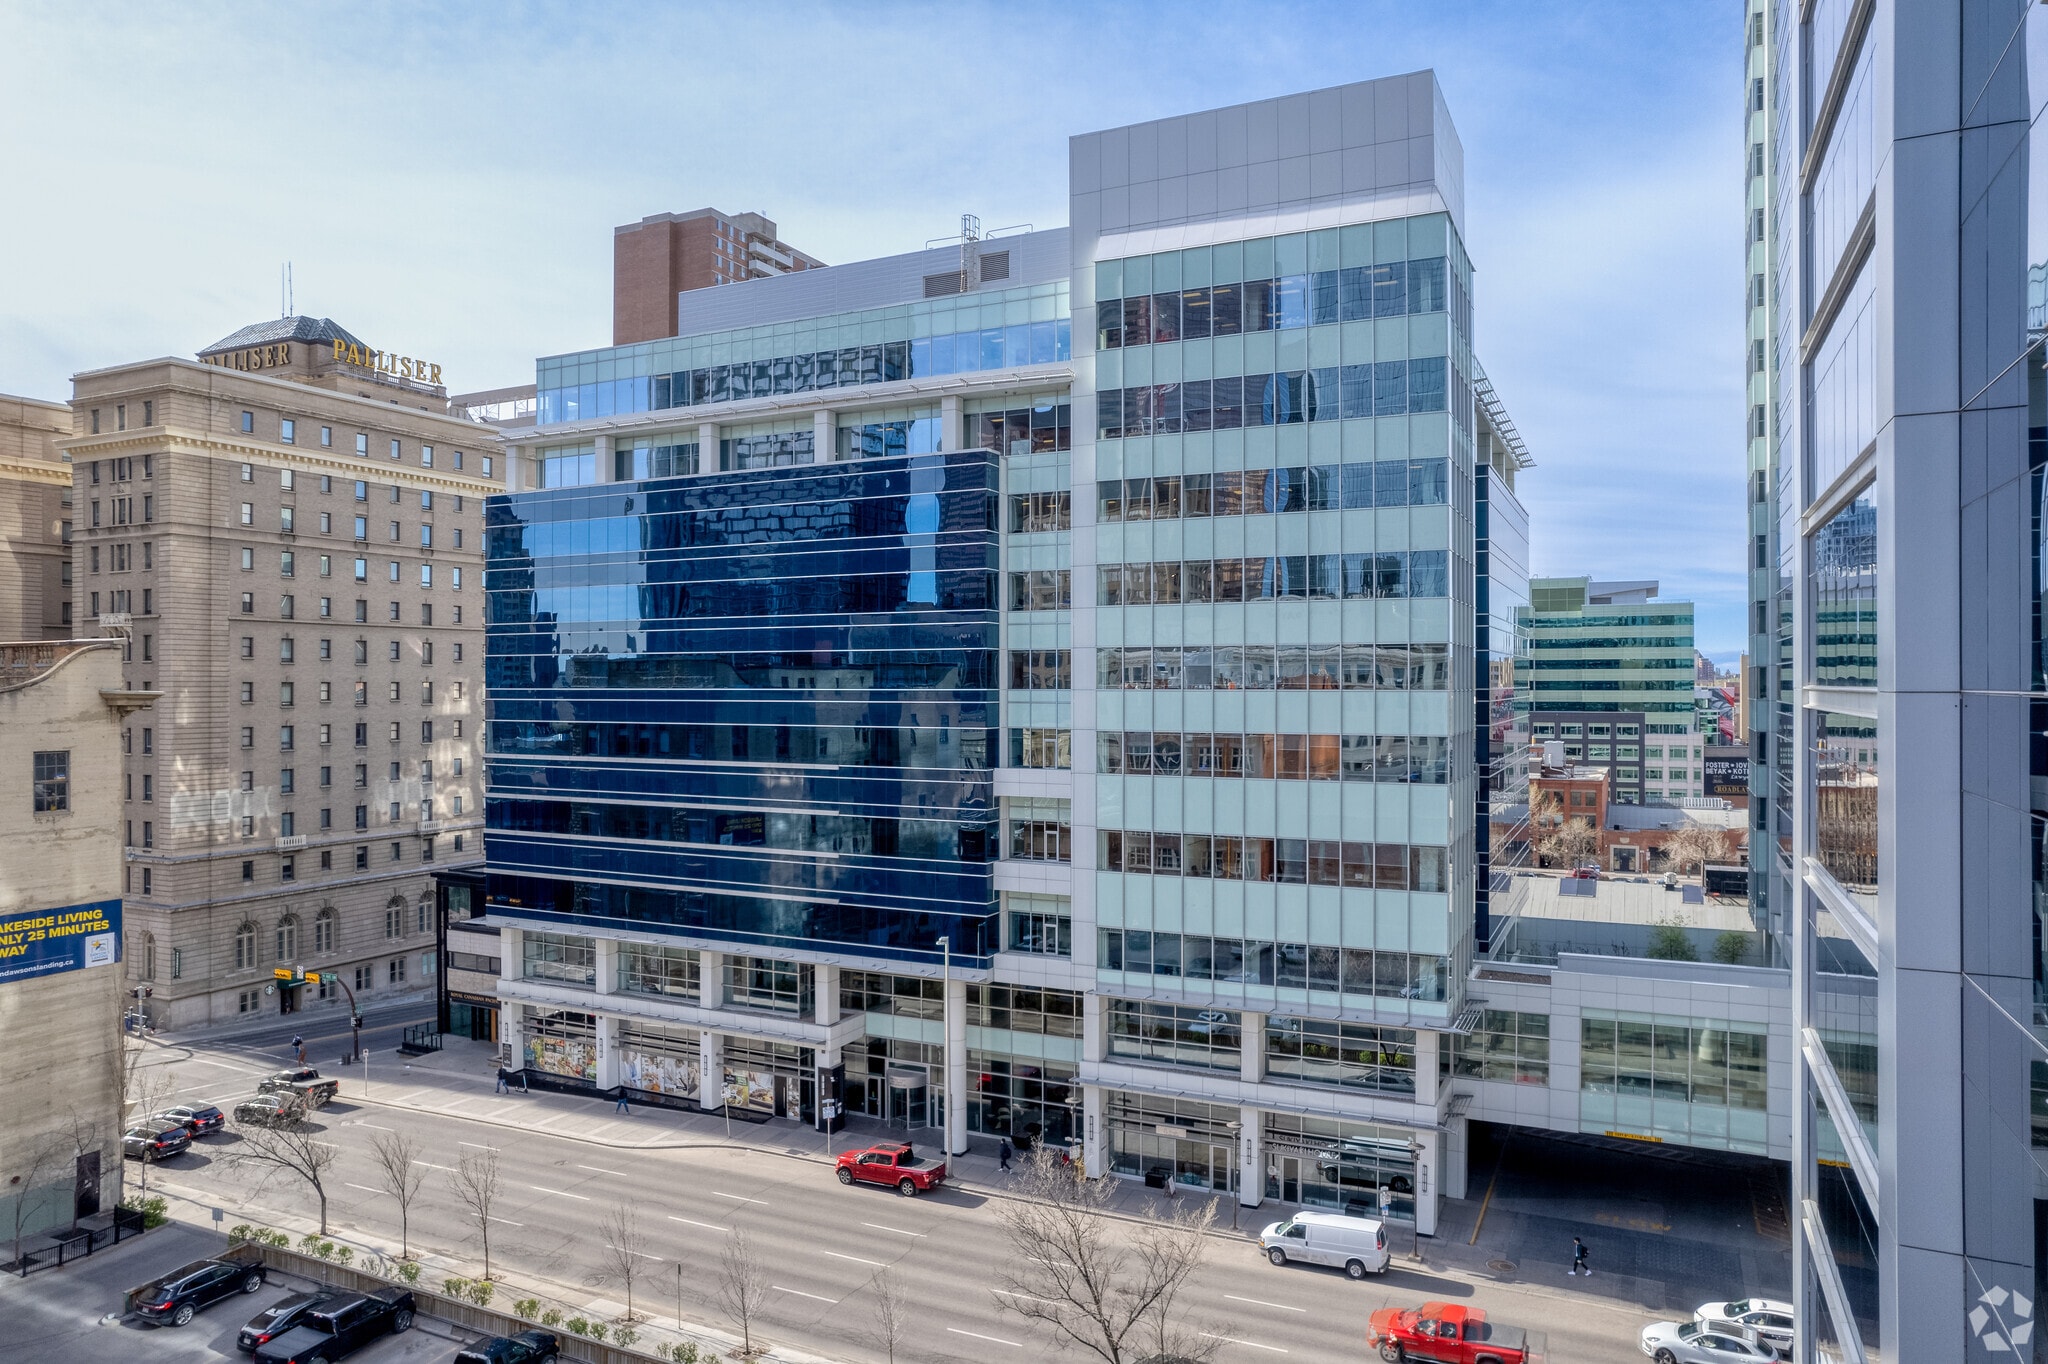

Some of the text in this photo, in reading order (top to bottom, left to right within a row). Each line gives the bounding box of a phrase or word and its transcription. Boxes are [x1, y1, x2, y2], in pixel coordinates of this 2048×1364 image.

[332, 338, 443, 384] PALLISER
[58, 910, 102, 924] LIVING
[0, 920, 110, 946] NLY 25 MINUTES
[0, 944, 28, 958] WAY
[0, 960, 74, 976] ndawsonslanding.ca
[1272, 1144, 1306, 1155] SUKIYAKI
